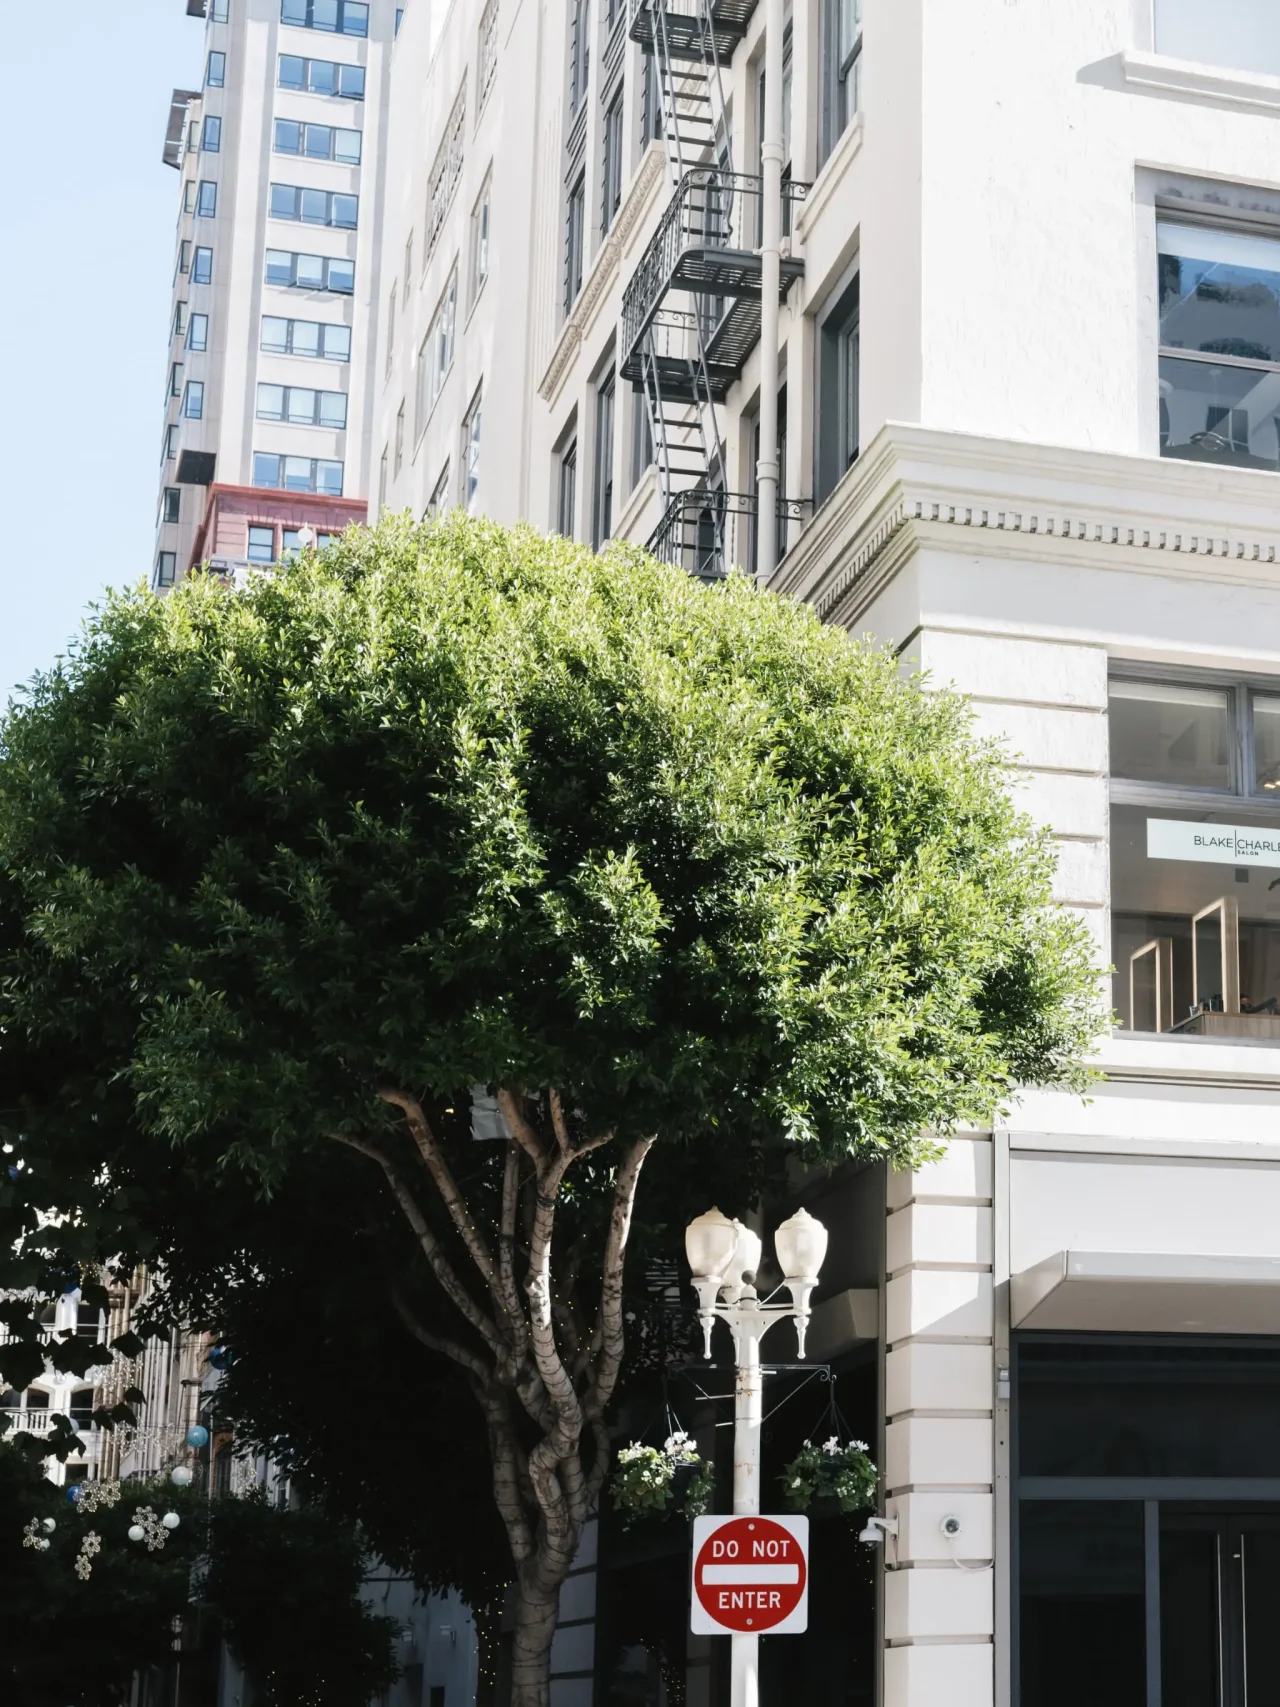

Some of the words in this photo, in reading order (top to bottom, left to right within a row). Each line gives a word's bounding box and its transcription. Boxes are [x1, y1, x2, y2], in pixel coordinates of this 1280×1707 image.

[1194, 835, 1234, 848] BLAKE
[713, 1540, 739, 1557] DO
[753, 1540, 790, 1557] NOT
[719, 1591, 781, 1609] ENTER
